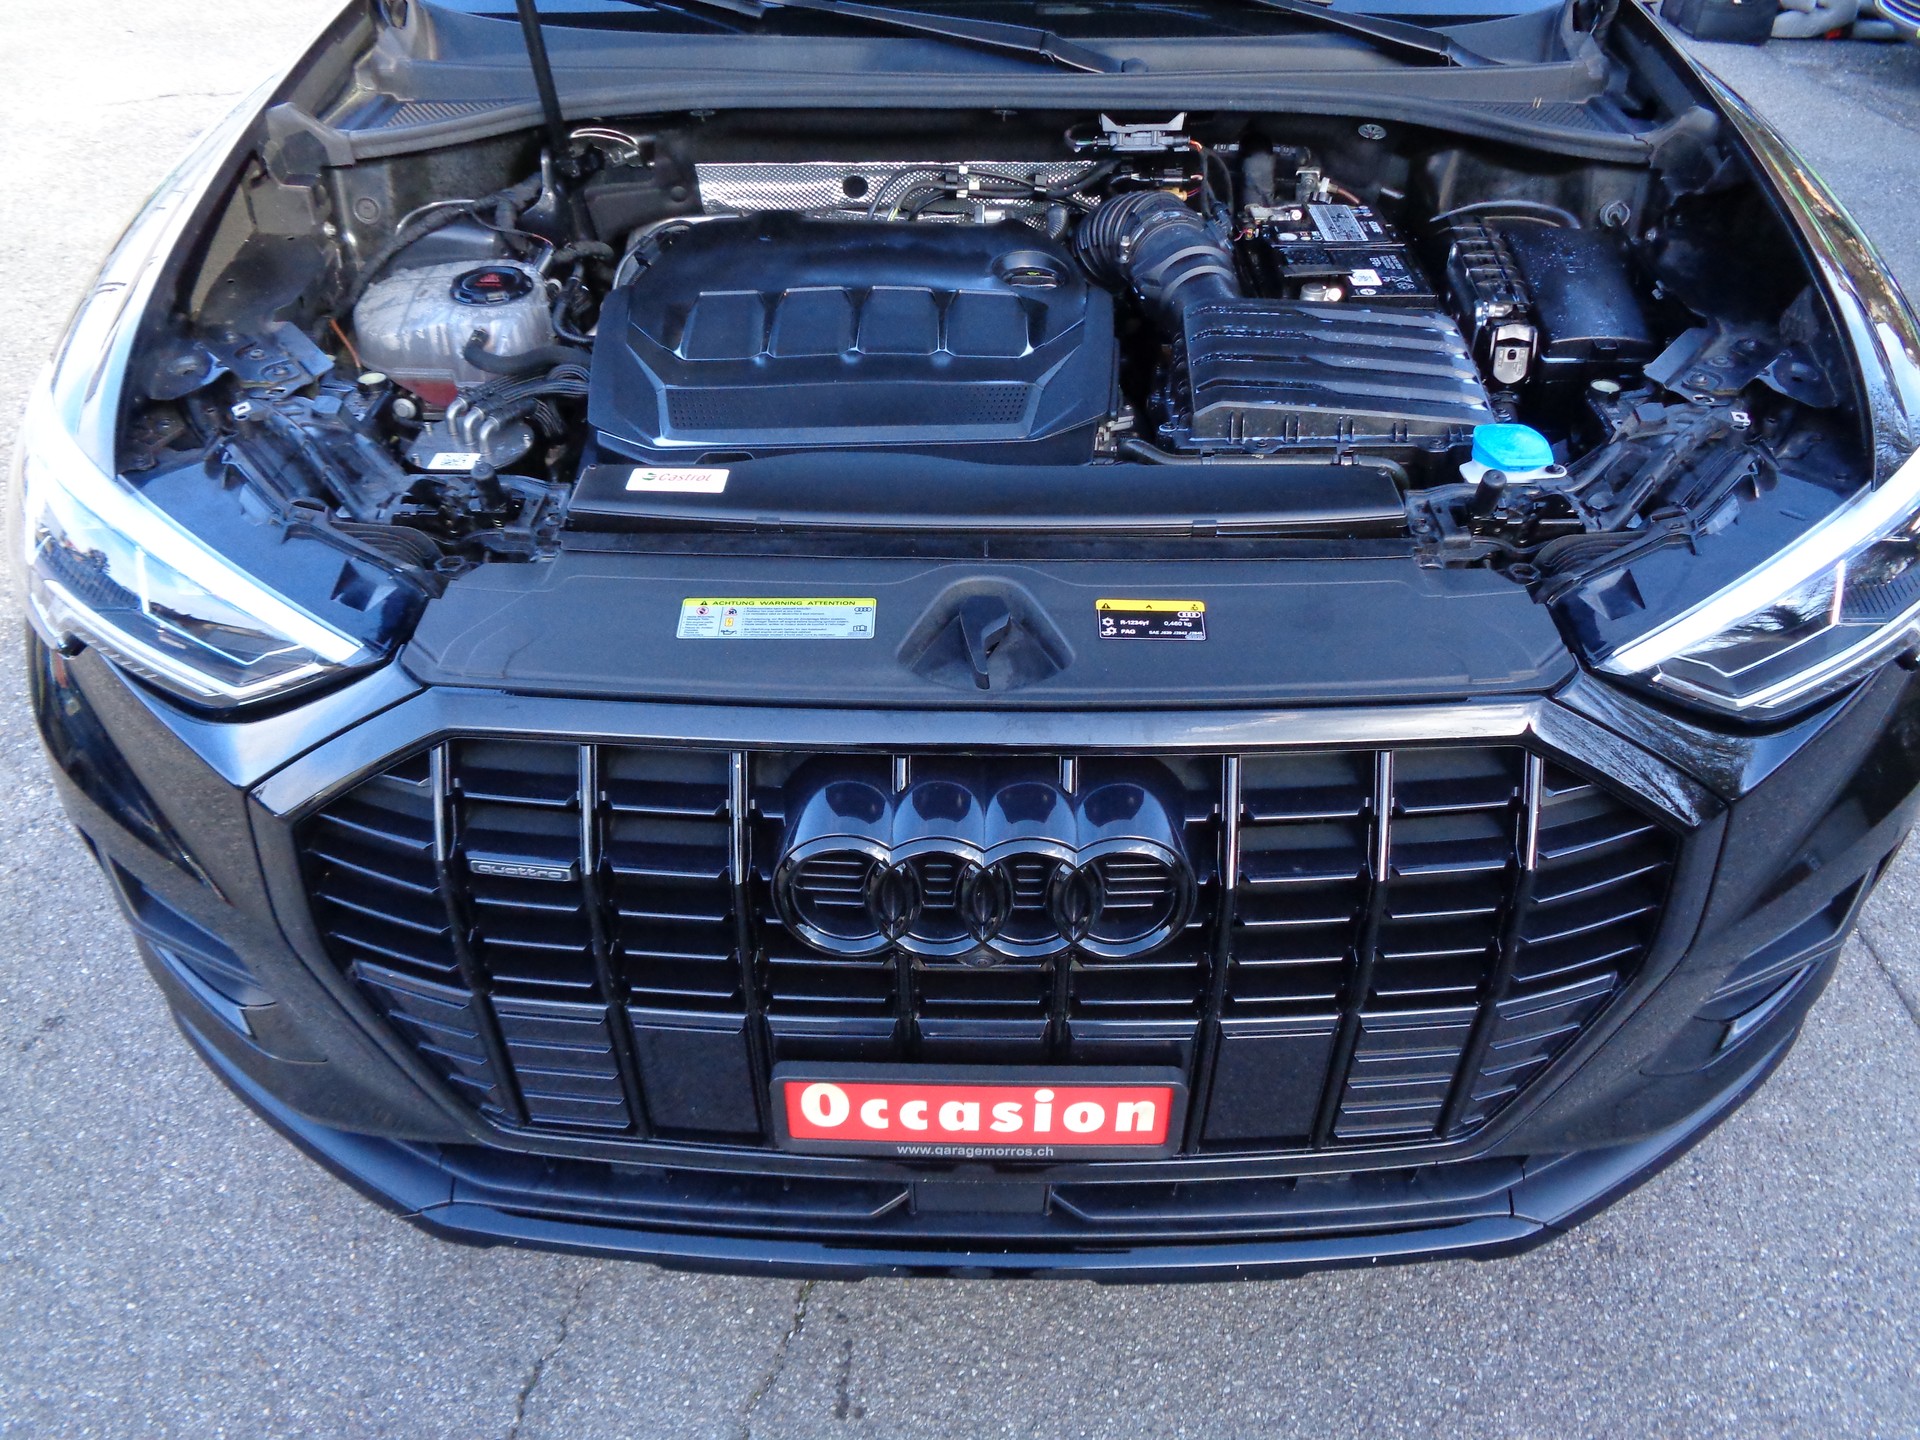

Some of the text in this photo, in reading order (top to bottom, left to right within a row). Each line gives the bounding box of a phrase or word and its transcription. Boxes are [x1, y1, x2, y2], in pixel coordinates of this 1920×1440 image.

[658, 473, 712, 482] Castrol
[478, 864, 562, 878] quattro
[799, 1082, 1157, 1134] Occasion
